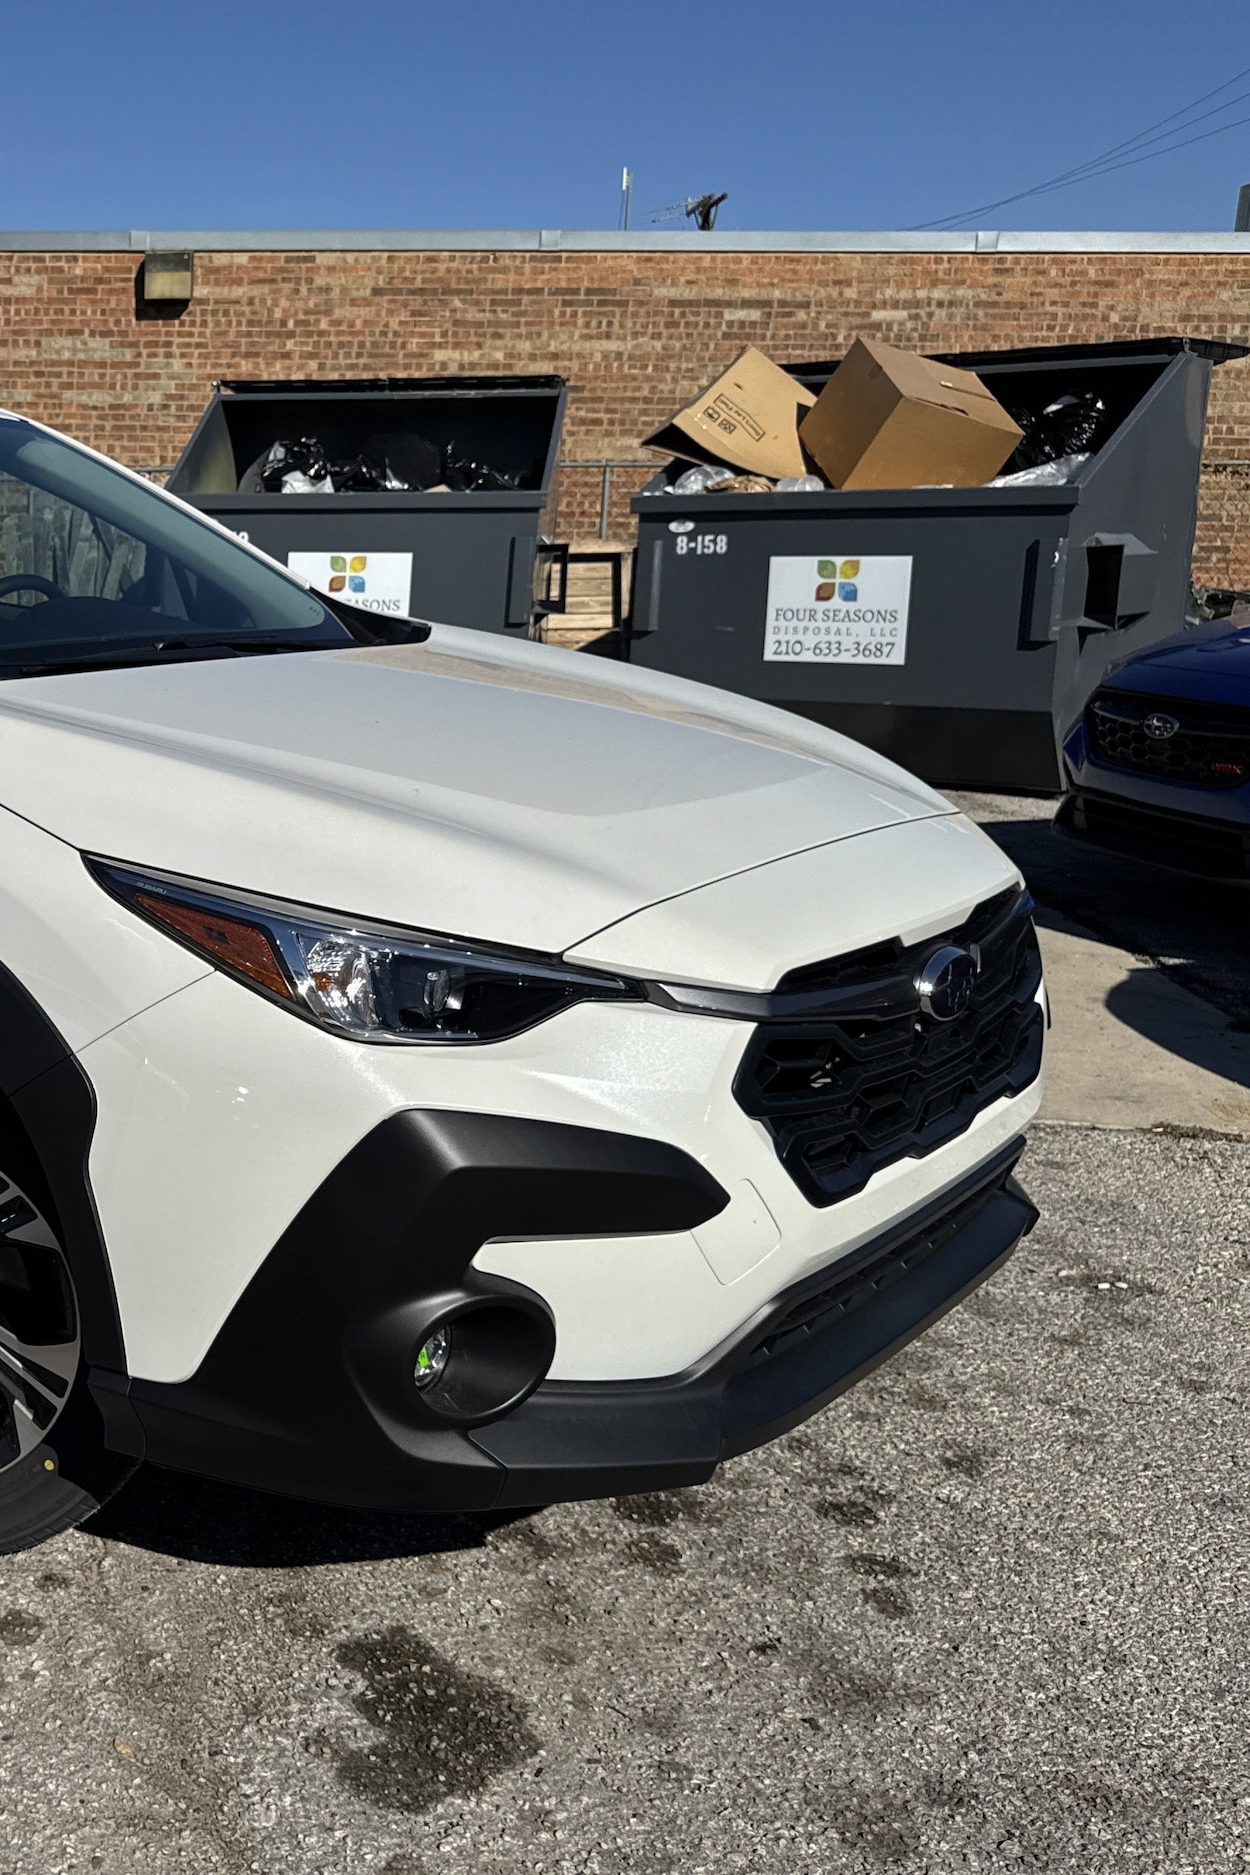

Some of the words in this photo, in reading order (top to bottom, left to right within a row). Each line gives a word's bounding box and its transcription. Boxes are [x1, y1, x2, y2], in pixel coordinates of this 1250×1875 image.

[676, 535, 727, 555] 8-158
[774, 608, 817, 622] FOUR
[821, 608, 898, 623] SEASONS
[773, 626, 859, 638] DISPOSAL,
[869, 628, 898, 638] LLC
[772, 640, 895, 658] 210-633-3687
[136, 882, 167, 895] SUBARU
